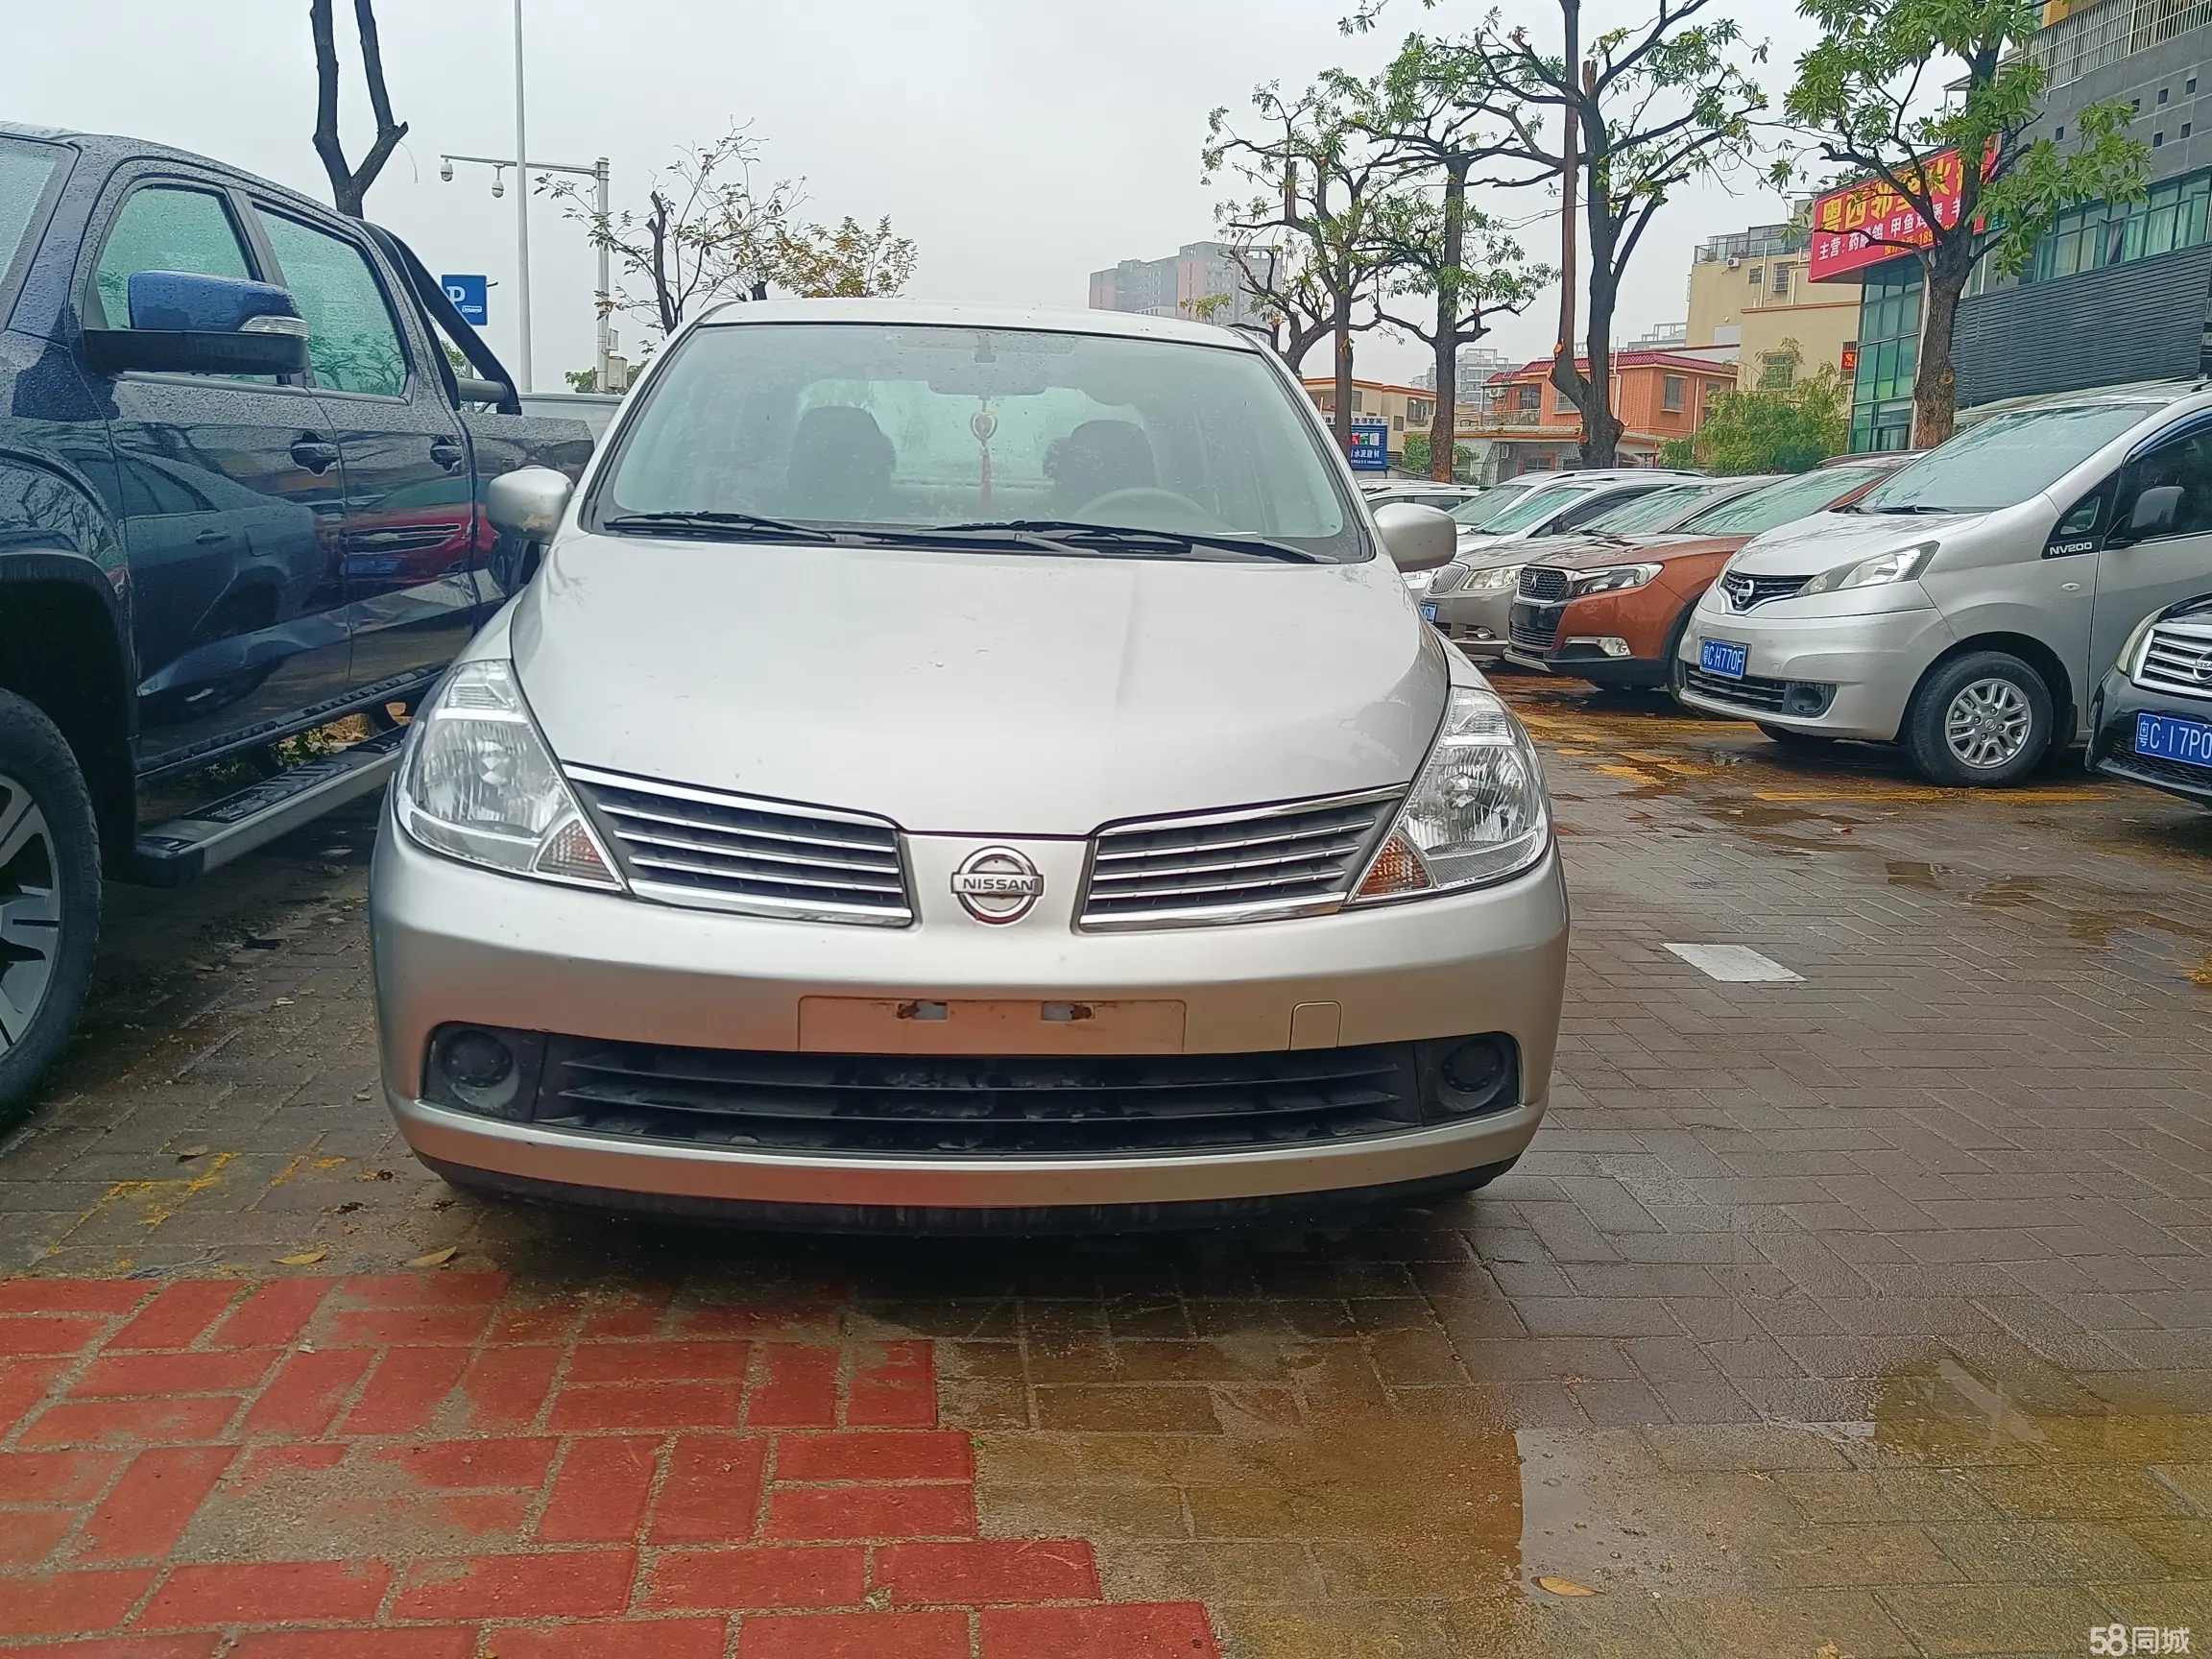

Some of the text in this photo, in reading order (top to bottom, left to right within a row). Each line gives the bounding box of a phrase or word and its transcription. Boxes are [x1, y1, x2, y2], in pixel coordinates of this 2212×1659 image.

[445, 285, 466, 303] P
[2050, 541, 2093, 555] NV200
[963, 878, 1034, 891] NISSAN
